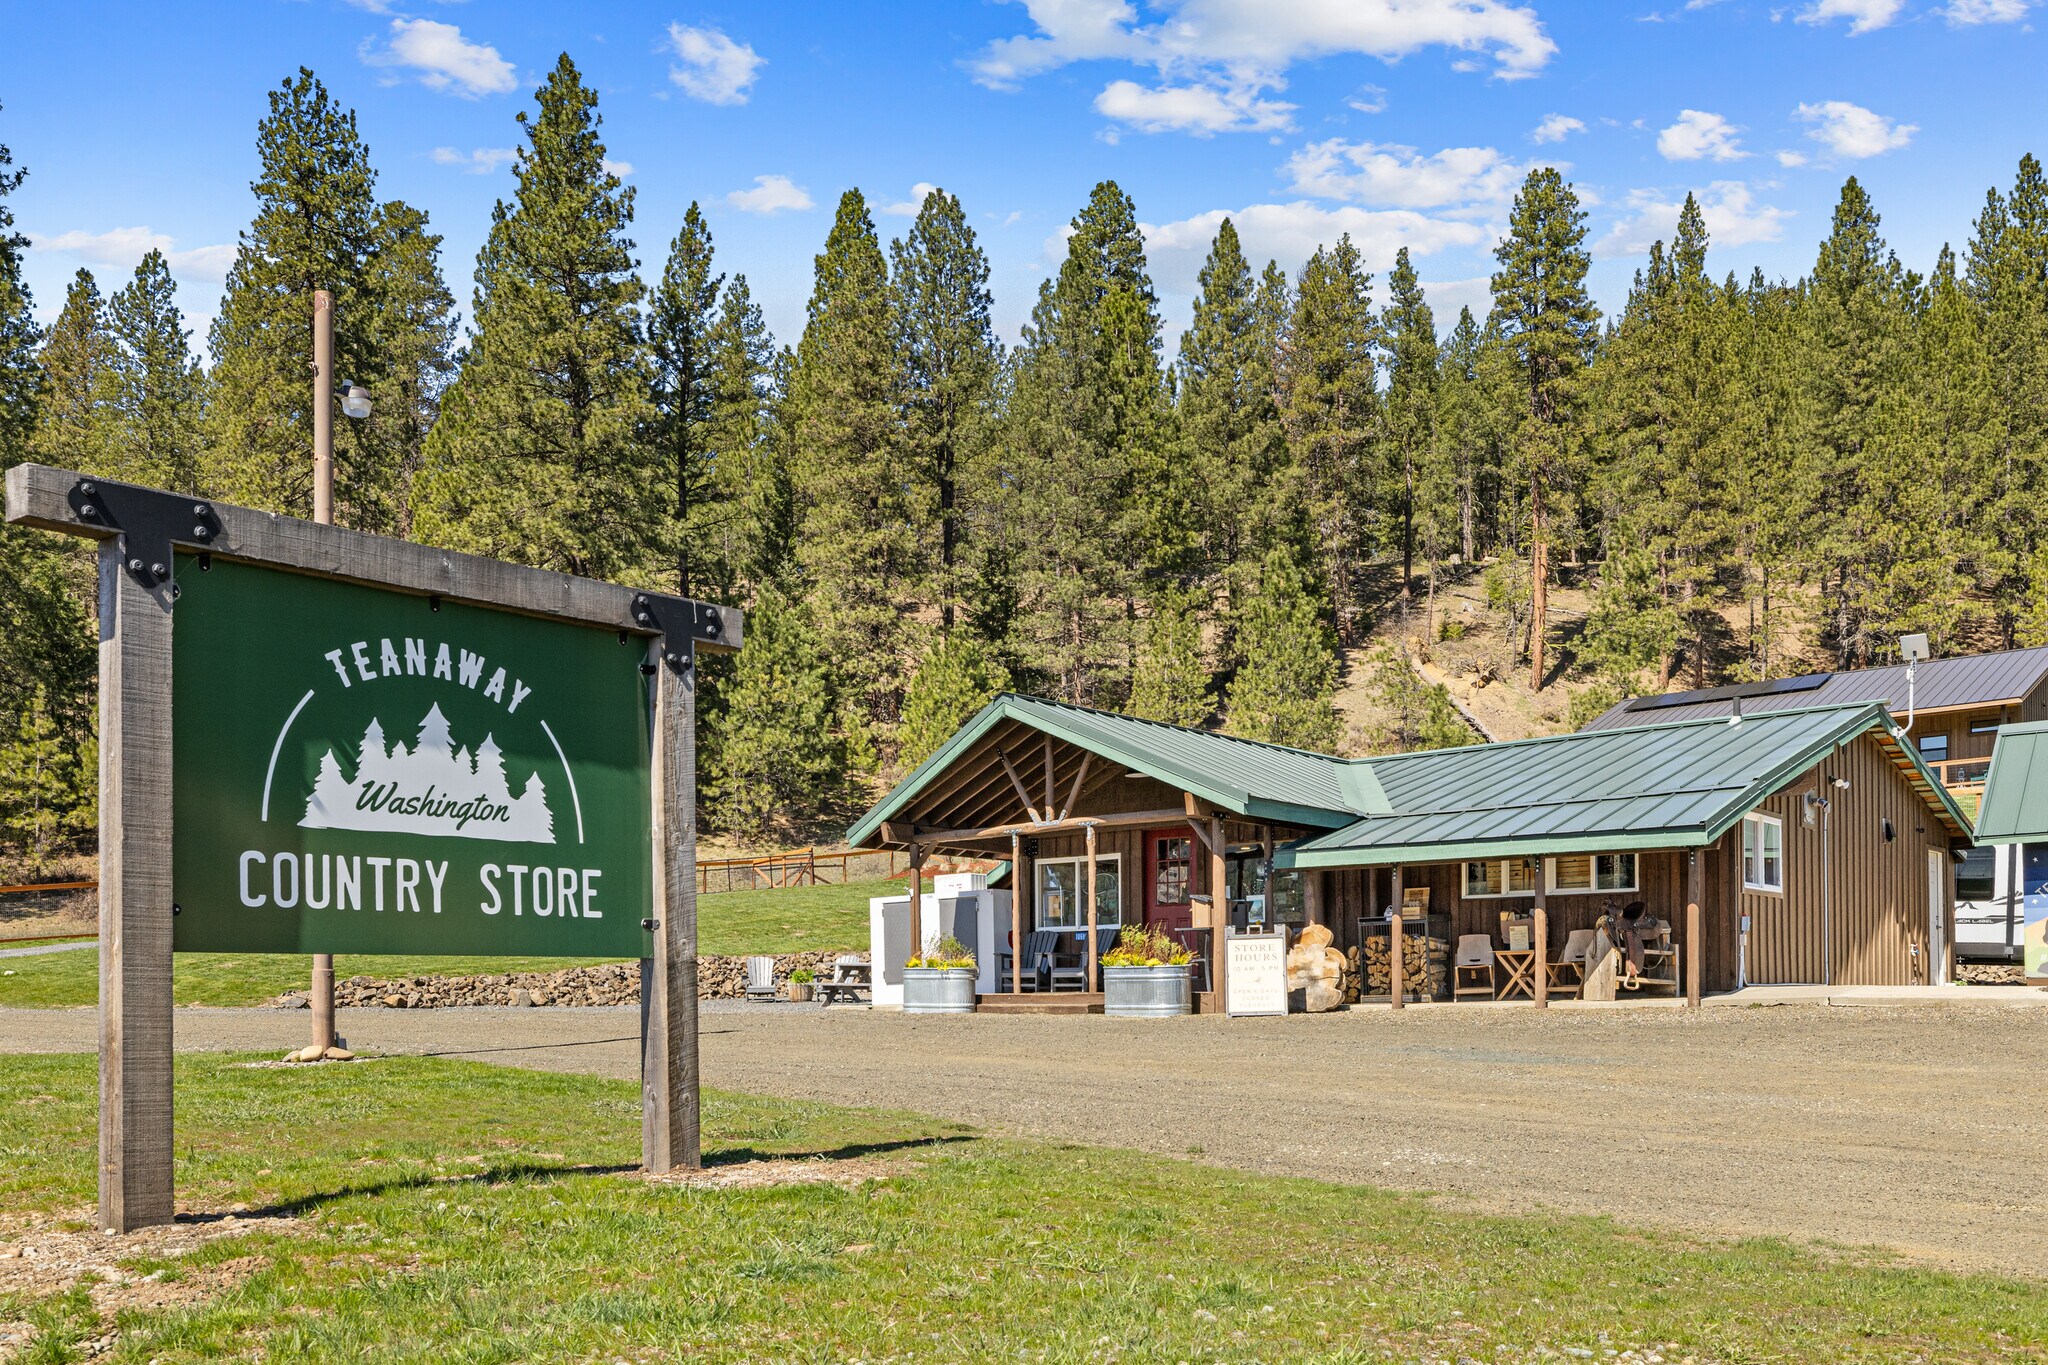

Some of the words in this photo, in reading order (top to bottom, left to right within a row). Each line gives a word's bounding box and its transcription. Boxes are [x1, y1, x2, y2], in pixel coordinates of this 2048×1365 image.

[325, 638, 532, 713] TEANAWAY
[355, 780, 510, 830] Washington
[240, 850, 449, 913] COUNTRY
[480, 863, 603, 918] STORE
[1234, 944, 1275, 952] STORE
[1235, 953, 1278, 962] HOURS
